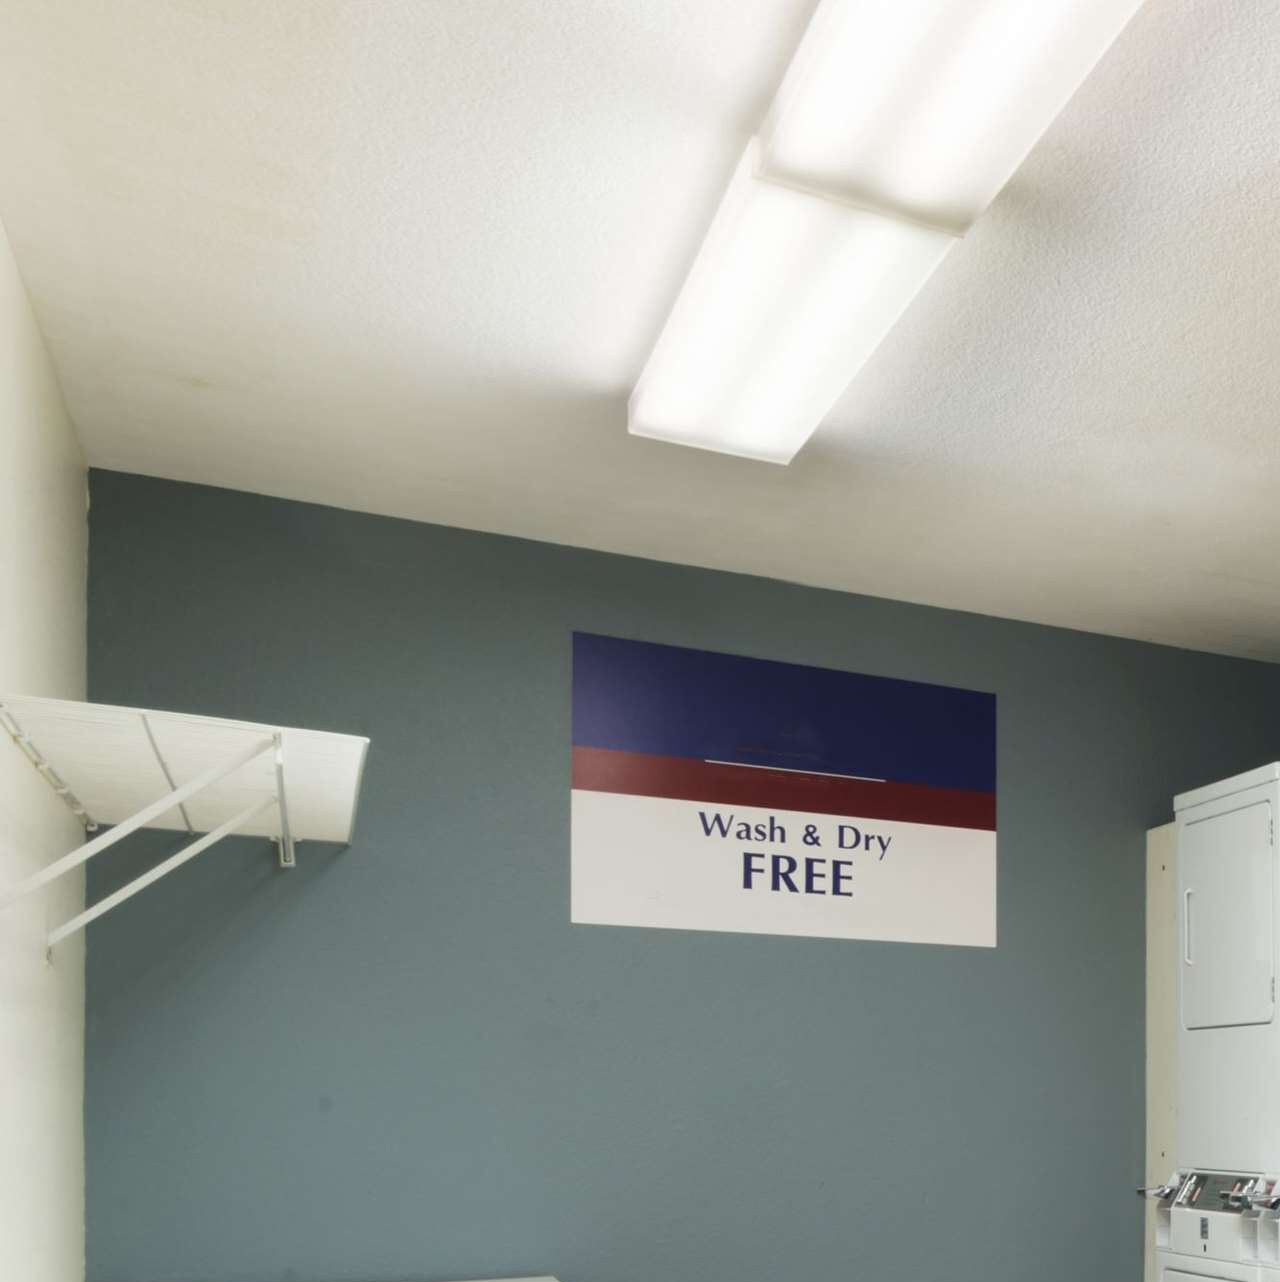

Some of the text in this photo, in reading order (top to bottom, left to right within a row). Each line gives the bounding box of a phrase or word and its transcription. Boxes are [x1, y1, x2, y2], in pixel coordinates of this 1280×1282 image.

[698, 811, 893, 861] Wash & Dry
[742, 851, 854, 898] FREE
